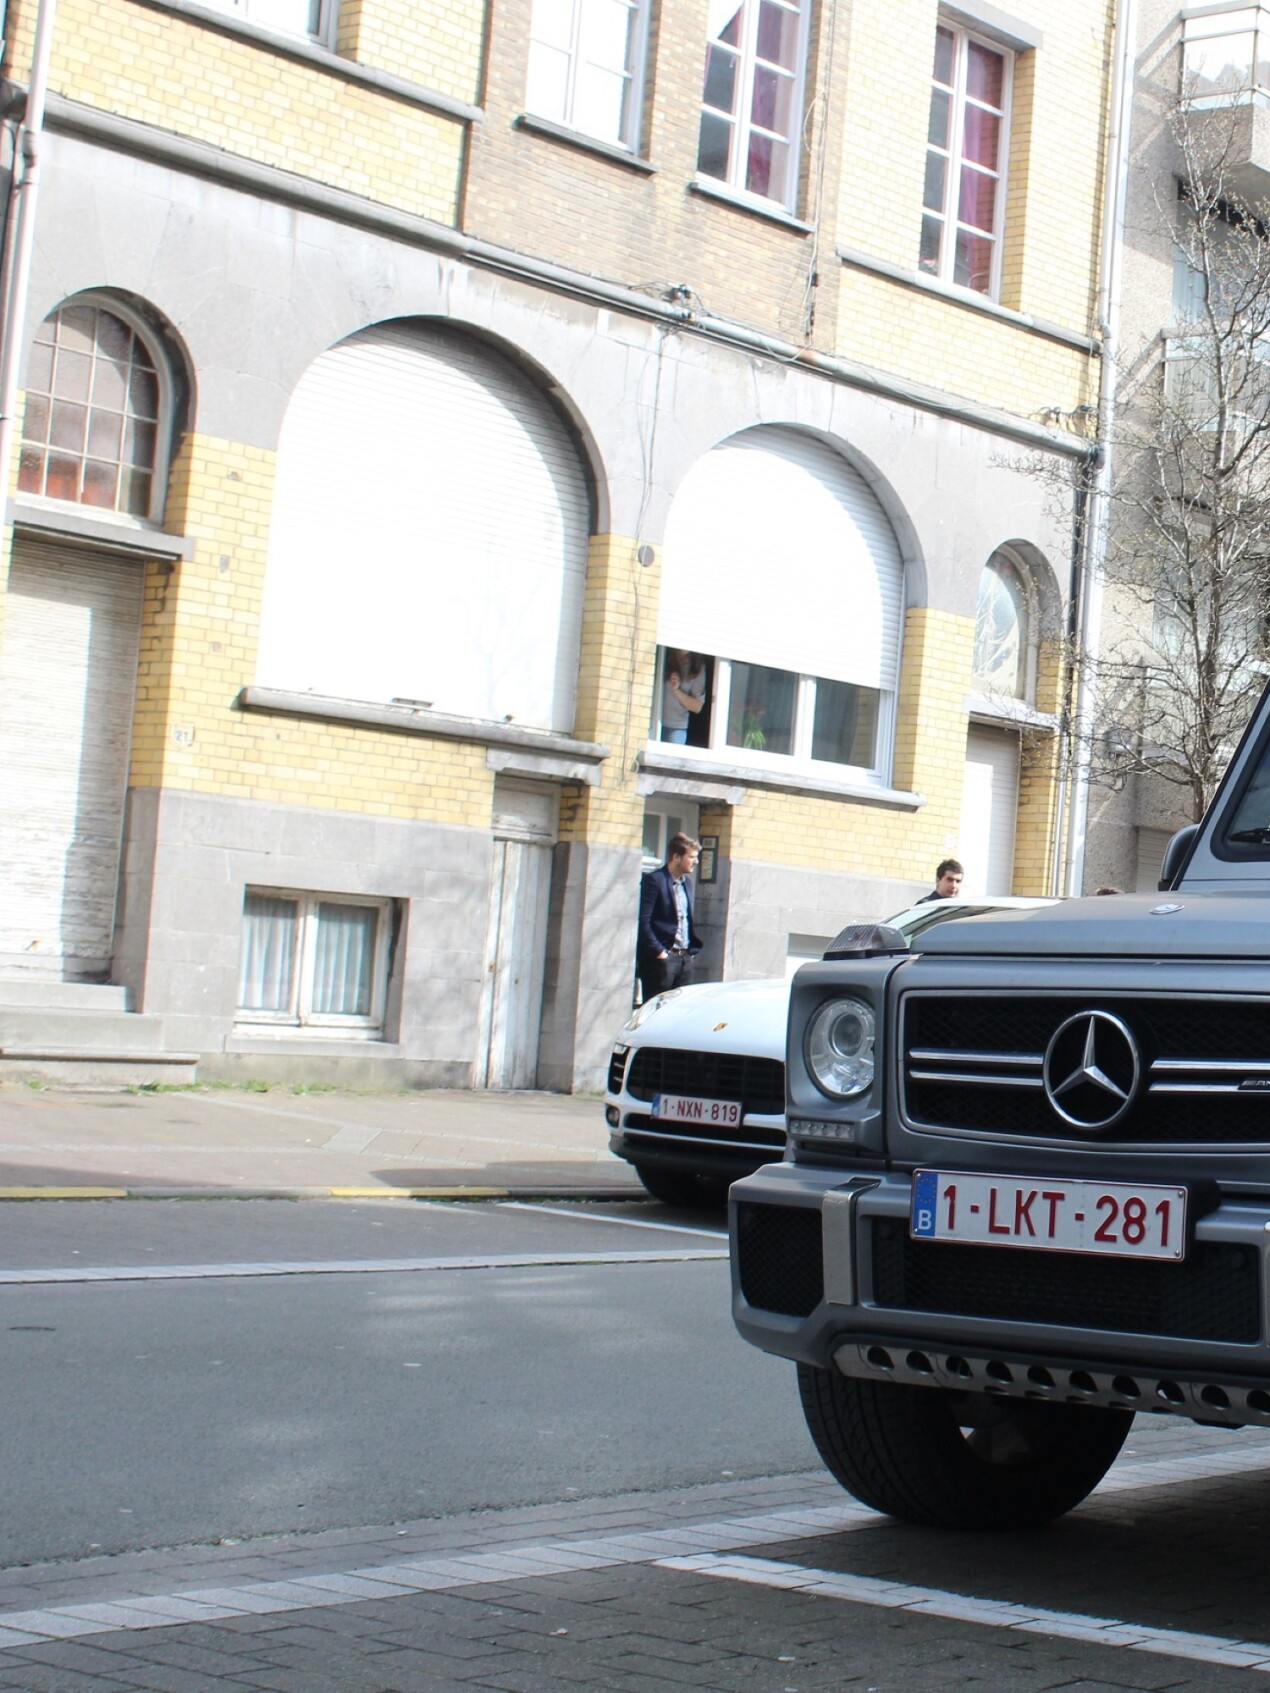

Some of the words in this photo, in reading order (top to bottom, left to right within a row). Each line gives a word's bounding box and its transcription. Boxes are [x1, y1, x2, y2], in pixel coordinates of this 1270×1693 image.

[662, 1098, 738, 1123] 1-NXN-819
[917, 1209, 932, 1231] B
[943, 1183, 1171, 1248] 1-LKT-281
